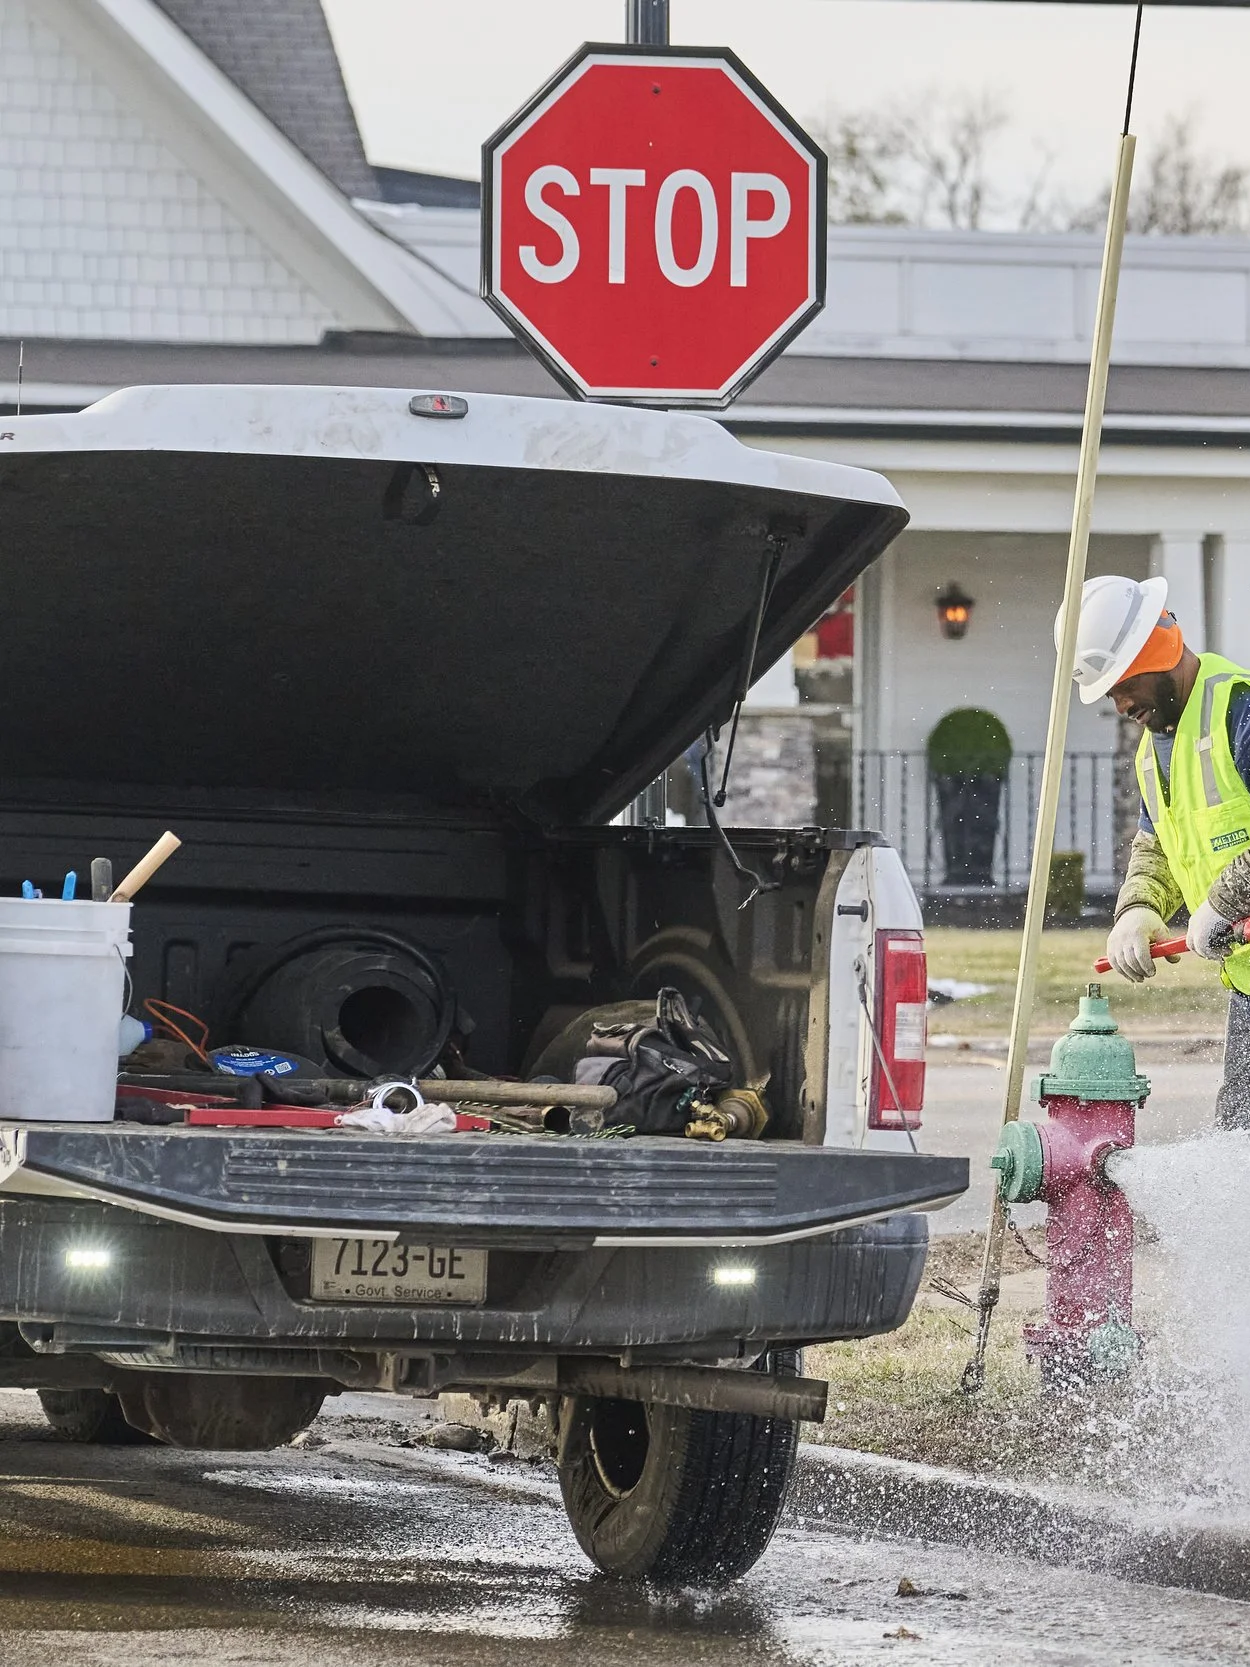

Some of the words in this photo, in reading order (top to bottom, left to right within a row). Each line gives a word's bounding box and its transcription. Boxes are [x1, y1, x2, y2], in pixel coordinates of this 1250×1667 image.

[518, 164, 791, 288] STOP
[332, 1237, 466, 1280] 7123-GE
[394, 1285, 442, 1299] Service
